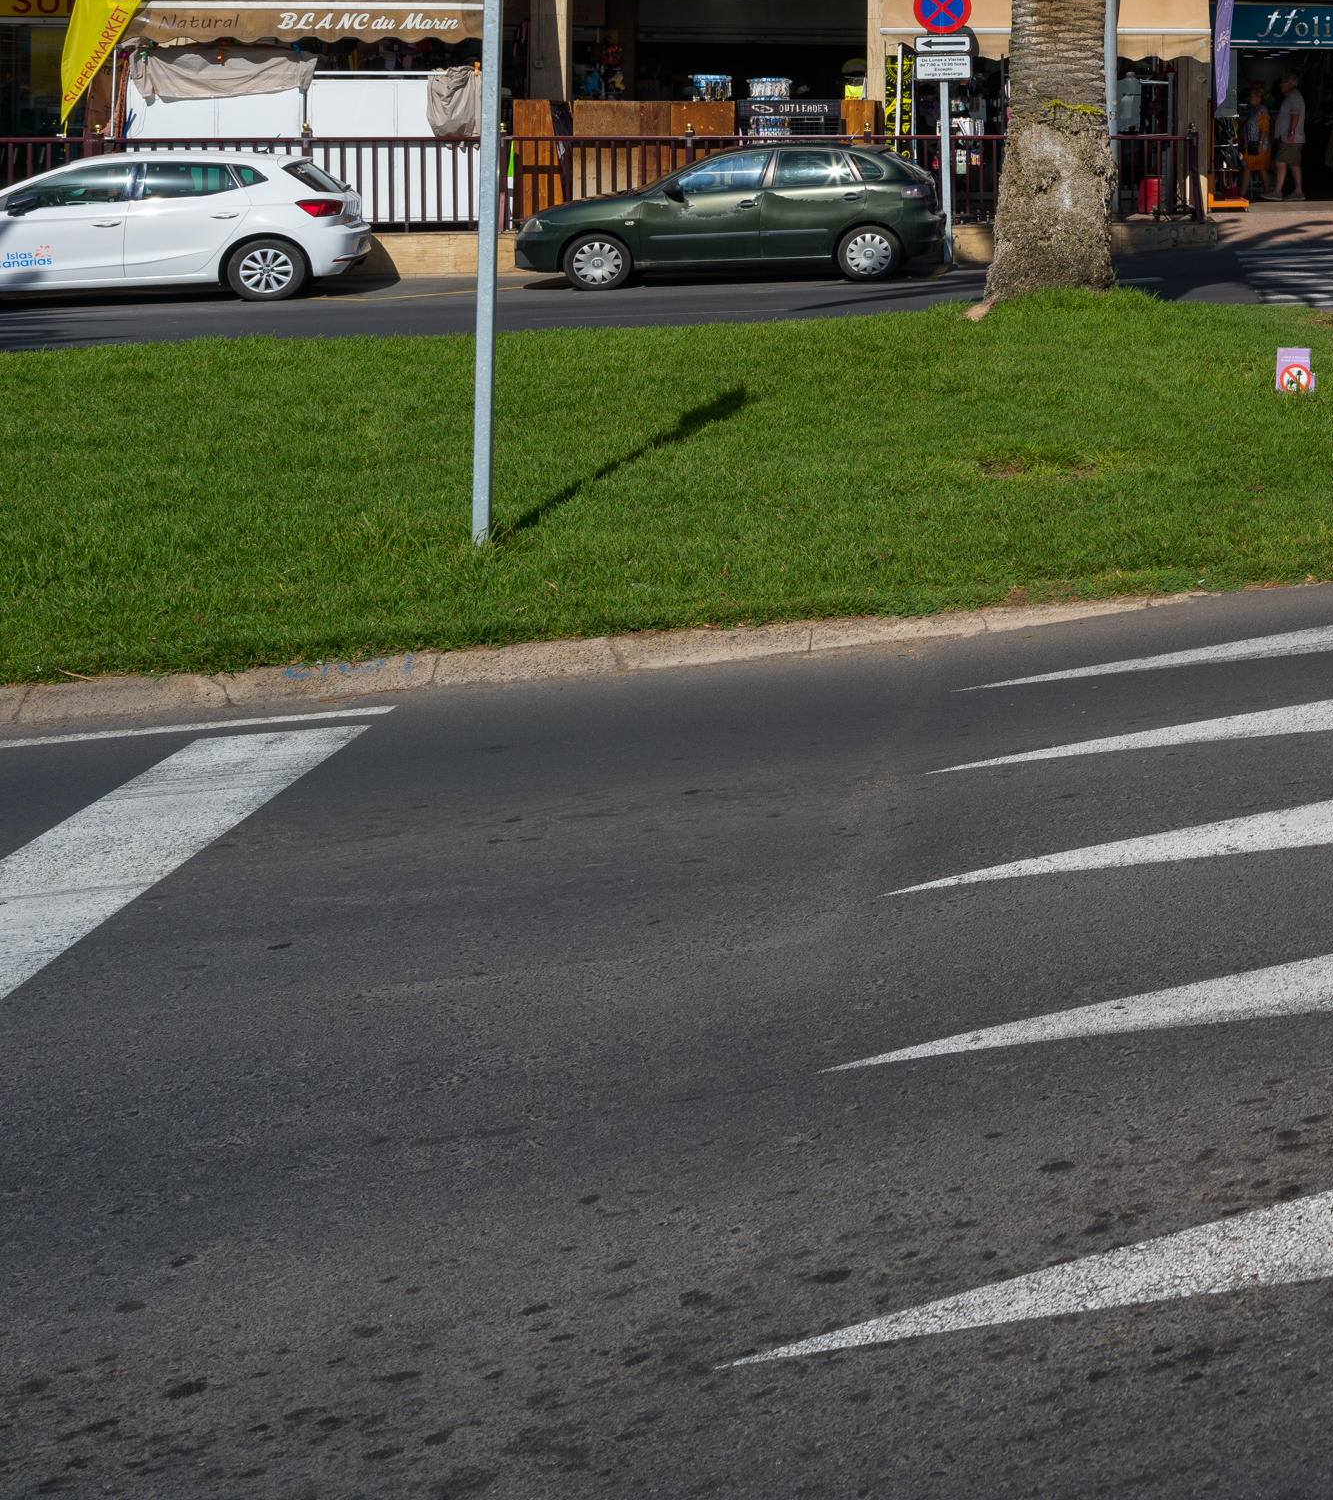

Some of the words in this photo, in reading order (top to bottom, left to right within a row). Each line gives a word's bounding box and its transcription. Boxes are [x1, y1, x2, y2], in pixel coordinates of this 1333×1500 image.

[158, 13, 240, 29] Natural
[371, 15, 396, 30] du
[399, 12, 459, 30] Marin
[778, 104, 829, 113] OUTLEADER
[6, 251, 33, 260] Islas
